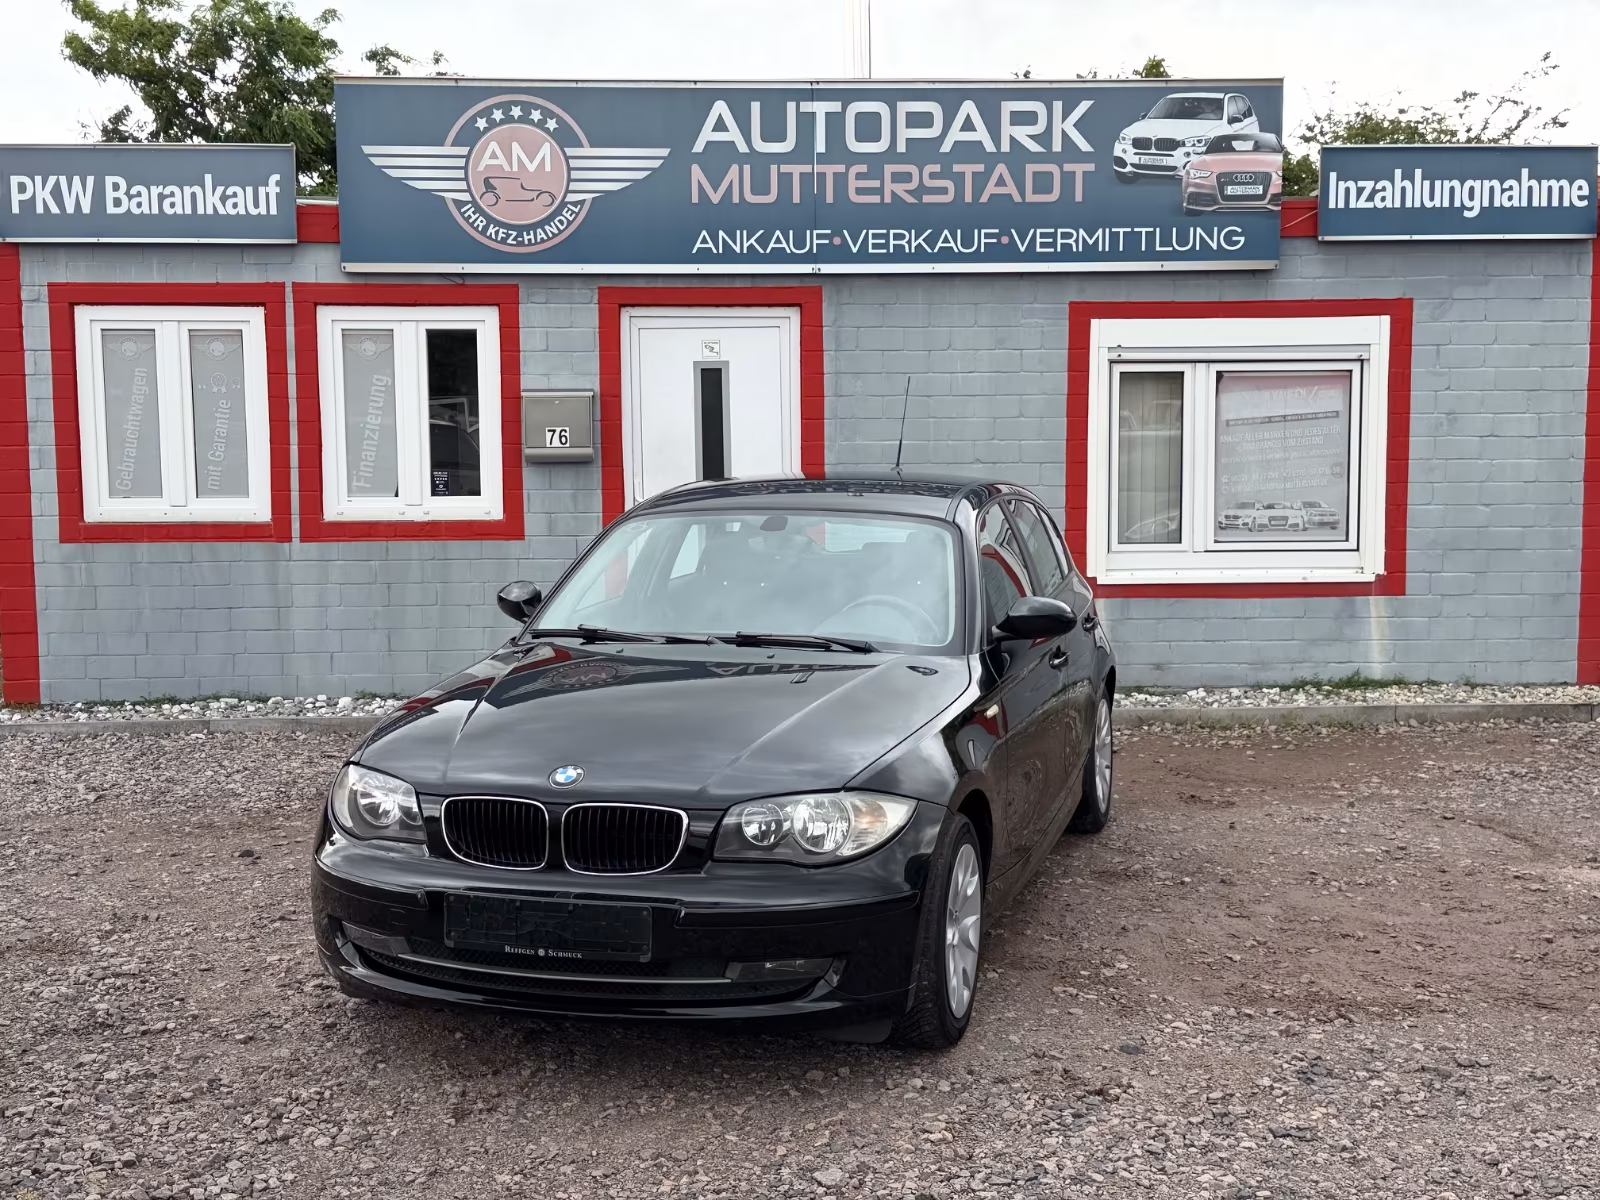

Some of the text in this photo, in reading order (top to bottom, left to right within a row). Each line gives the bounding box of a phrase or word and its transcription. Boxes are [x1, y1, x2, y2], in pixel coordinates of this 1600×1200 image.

[691, 100, 1096, 153] AUTOPARK
[476, 141, 552, 172] AM
[10, 173, 281, 216] PKW Barankauf
[691, 163, 1096, 204] MUTTERSTADT
[1328, 168, 1590, 218] Inzahlungnahme
[460, 203, 581, 245] IHR KFZ-HANDEL
[692, 226, 1246, 254] ANKAUF VERKAUF VERMITTLUNG
[115, 367, 149, 490] Gebrauchtwagen
[204, 399, 231, 490] mit Garantie
[351, 374, 392, 489] Finanzierung
[547, 428, 569, 446] 76
